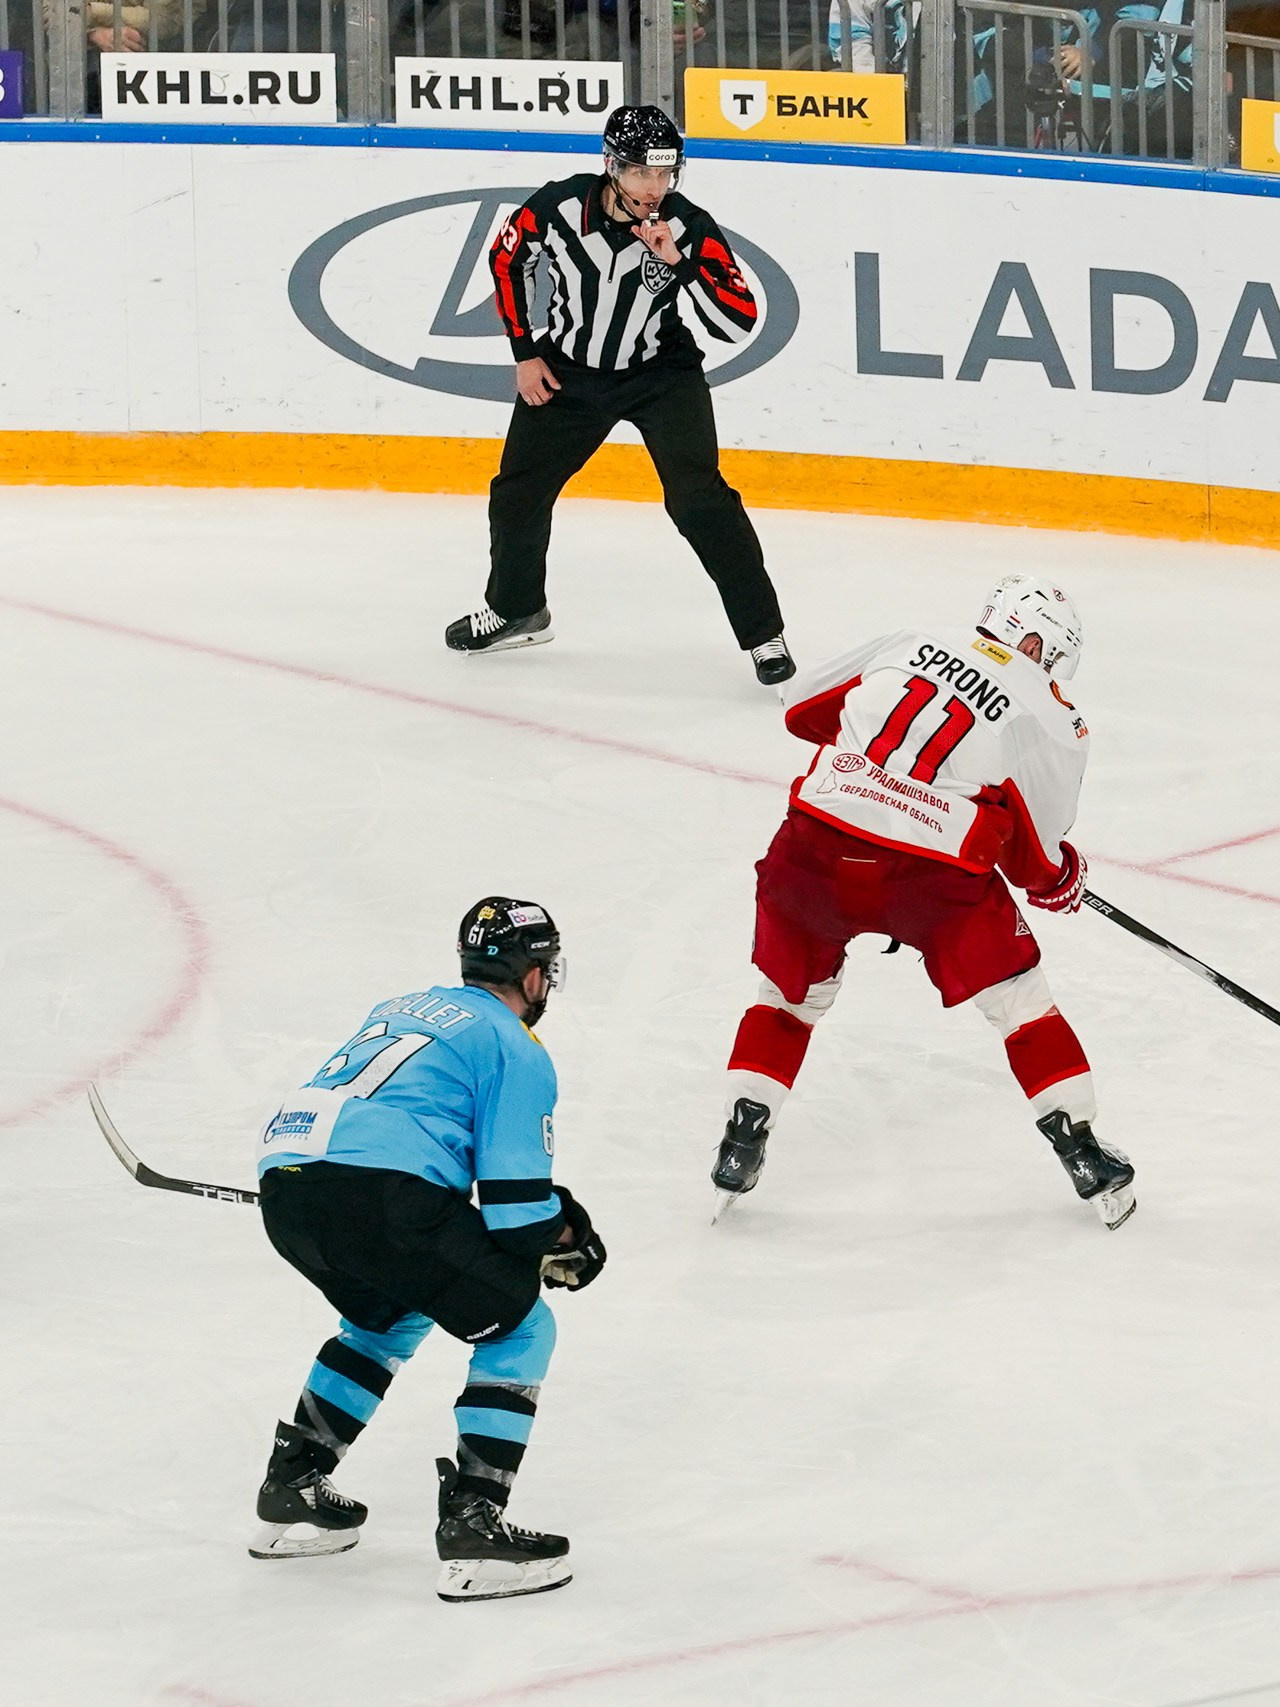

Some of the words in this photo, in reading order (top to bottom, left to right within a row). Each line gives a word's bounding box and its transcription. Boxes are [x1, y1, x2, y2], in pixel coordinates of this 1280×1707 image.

[116, 70, 321, 105] KHL.RU
[410, 74, 609, 116] KHL.RU
[776, 95, 869, 119] БАНК
[909, 644, 1010, 722] SPRONG
[864, 674, 976, 786] 11
[840, 783, 908, 813] СВЕРДЛОВСКАЯ
[909, 807, 943, 833] ОБЛАСТЬ
[866, 765, 951, 814] УРАЛМАШЗАВОД
[467, 924, 485, 946] 61
[192, 1186, 260, 1208] TRU
